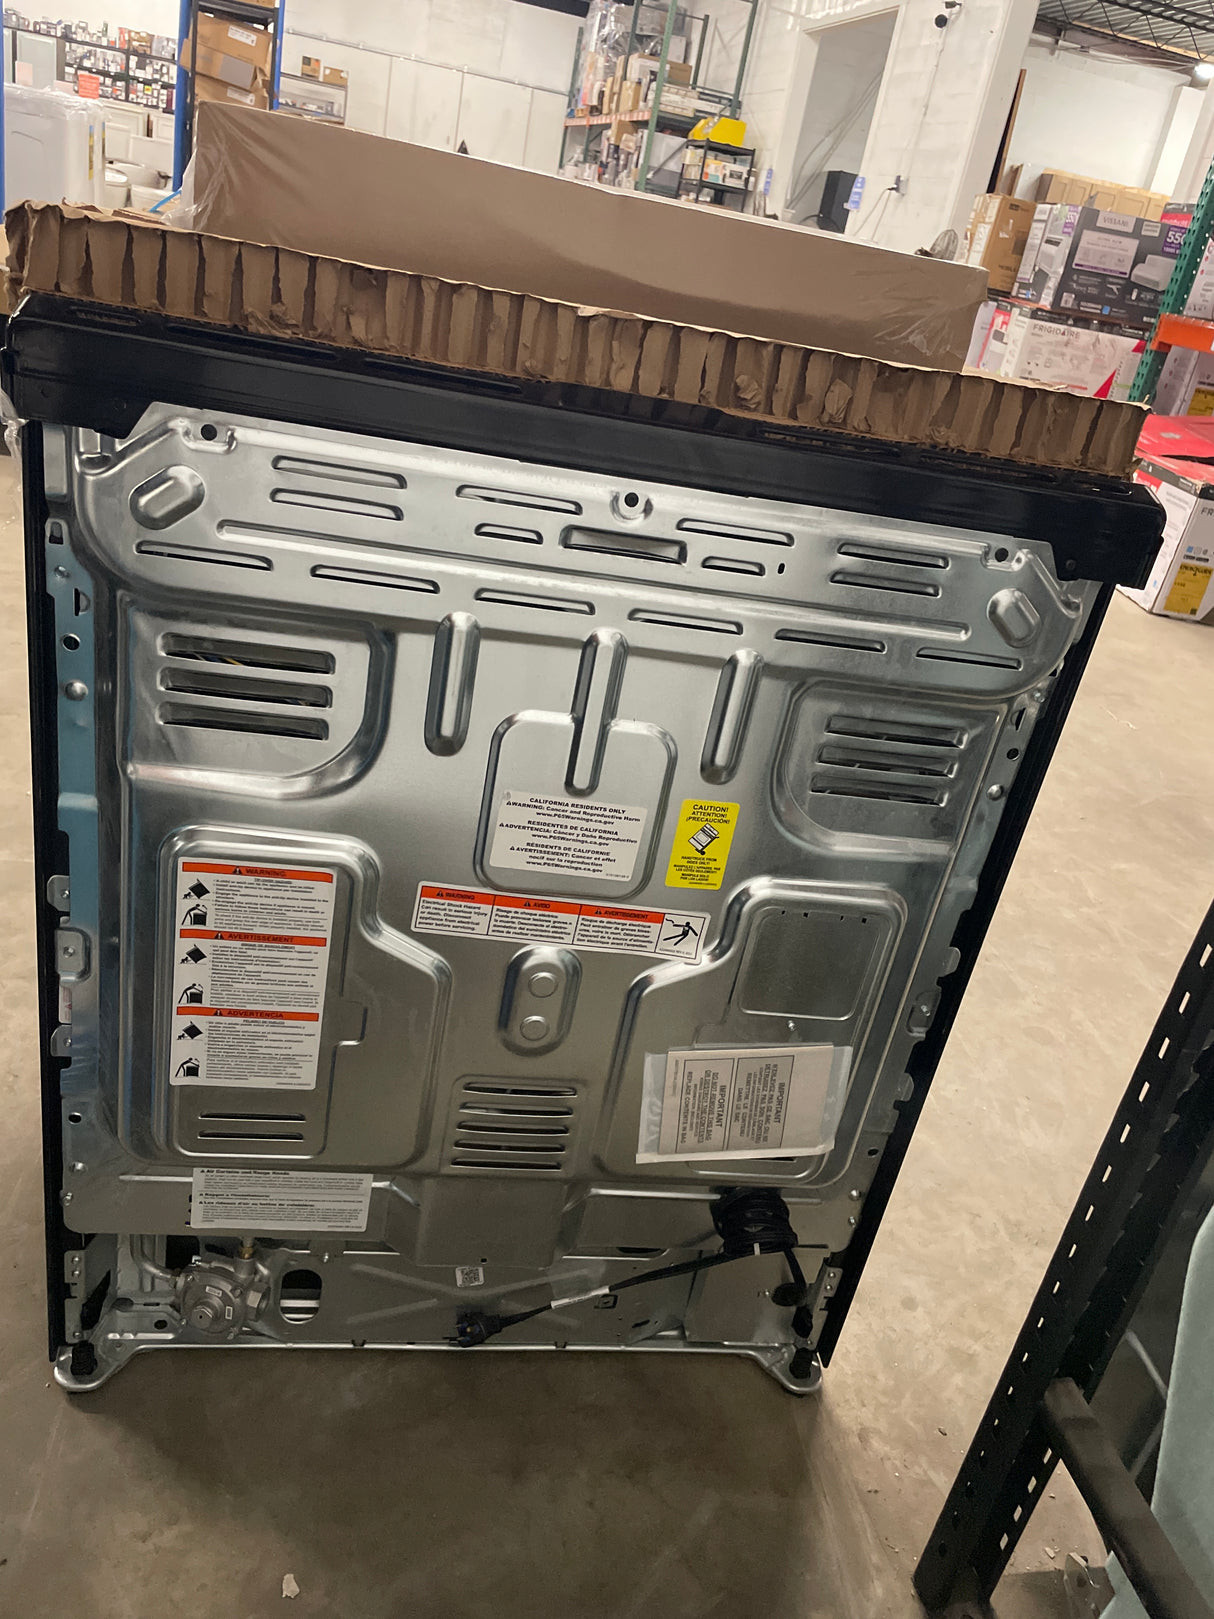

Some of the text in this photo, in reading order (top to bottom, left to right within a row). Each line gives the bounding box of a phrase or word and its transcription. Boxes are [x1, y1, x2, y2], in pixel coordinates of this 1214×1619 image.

[1033, 324, 1080, 339] FRIGIDAIRE
[511, 801, 545, 809] WARNING:
[582, 811, 622, 820] Reproductive
[530, 798, 569, 806] CALIFORNIA
[571, 803, 607, 811] RESIDENTS
[528, 820, 568, 829] RESIDENTES
[580, 826, 618, 835] CALIFORNIA
[228, 933, 294, 943] AVERTISSEMENT
[716, 1085, 726, 1127] IMPORTANT
[774, 1082, 785, 1123] IMPORTANT
